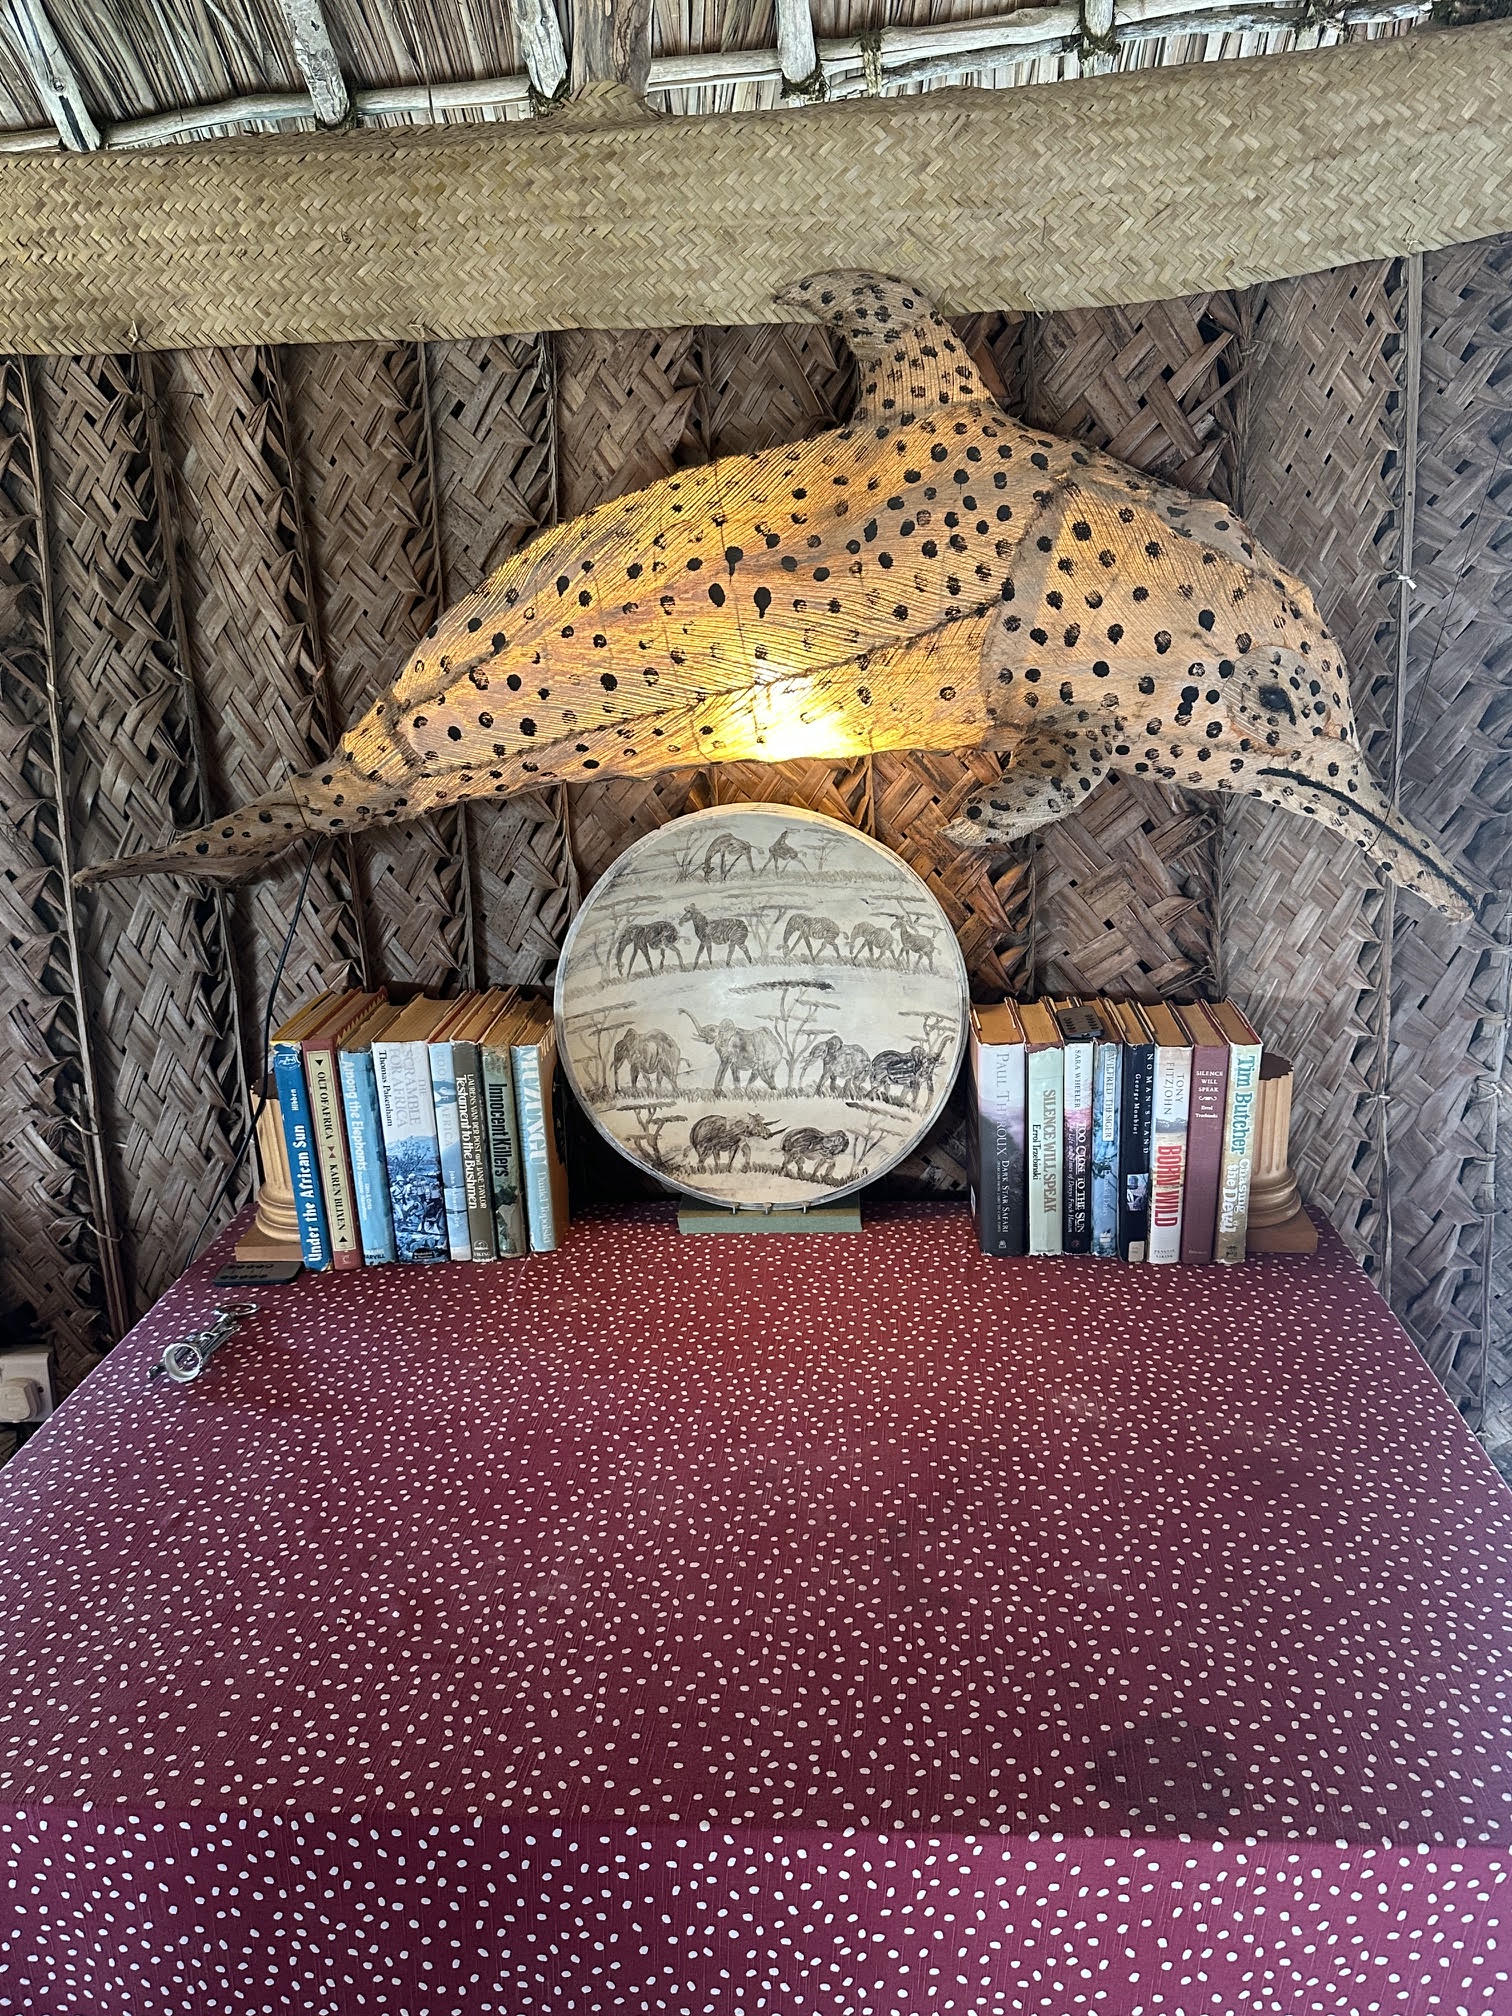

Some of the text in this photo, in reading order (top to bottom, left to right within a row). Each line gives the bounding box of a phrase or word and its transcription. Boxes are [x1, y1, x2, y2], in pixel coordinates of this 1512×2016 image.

[317, 1071, 334, 1139] OUT OF AFRICA
[342, 1061, 368, 1171] Among the Elephants
[378, 1049, 394, 1127] Thomas Pakenham
[390, 1047, 409, 1128] FOR AFRICA
[403, 1048, 422, 1125] SCRAMBLE
[418, 1079, 427, 1094] THE
[519, 1046, 548, 1166] MUZUNGU
[996, 1053, 1010, 1156] PAUL THROUX
[1104, 1051, 1115, 1138] WILFRED THESIGER
[1132, 1073, 1141, 1135] George Monbiot
[1143, 1053, 1154, 1154] NO MAN'S LAND
[1163, 1062, 1175, 1115] FITZJOHN
[1175, 1074, 1185, 1103] TONY
[1231, 1055, 1255, 1155] Tim Butcher
[456, 1074, 477, 1209] Testament to the Bushmen
[467, 1074, 487, 1209] LAURENS VAN DER POST and JANE TAYLOR
[488, 1083, 513, 1178] Innocent Killers
[1032, 1124, 1042, 1181] Errol Trzebinski
[1043, 1089, 1057, 1213] SILENCE WILL SPEAK
[293, 1125, 322, 1261] Under the African Sun
[329, 1164, 346, 1231] KAREN BLIXEN
[537, 1171, 548, 1202] Daniel
[1001, 1160, 1010, 1233] DARK STAR SAFARI
[1075, 1120, 1087, 1233] TOO CLOSE TO THE SUN
[1154, 1145, 1182, 1227] BORN WILD
[1219, 1187, 1238, 1233] Devil
[1226, 1164, 1239, 1187] the
[1233, 1158, 1250, 1213] Chasing
